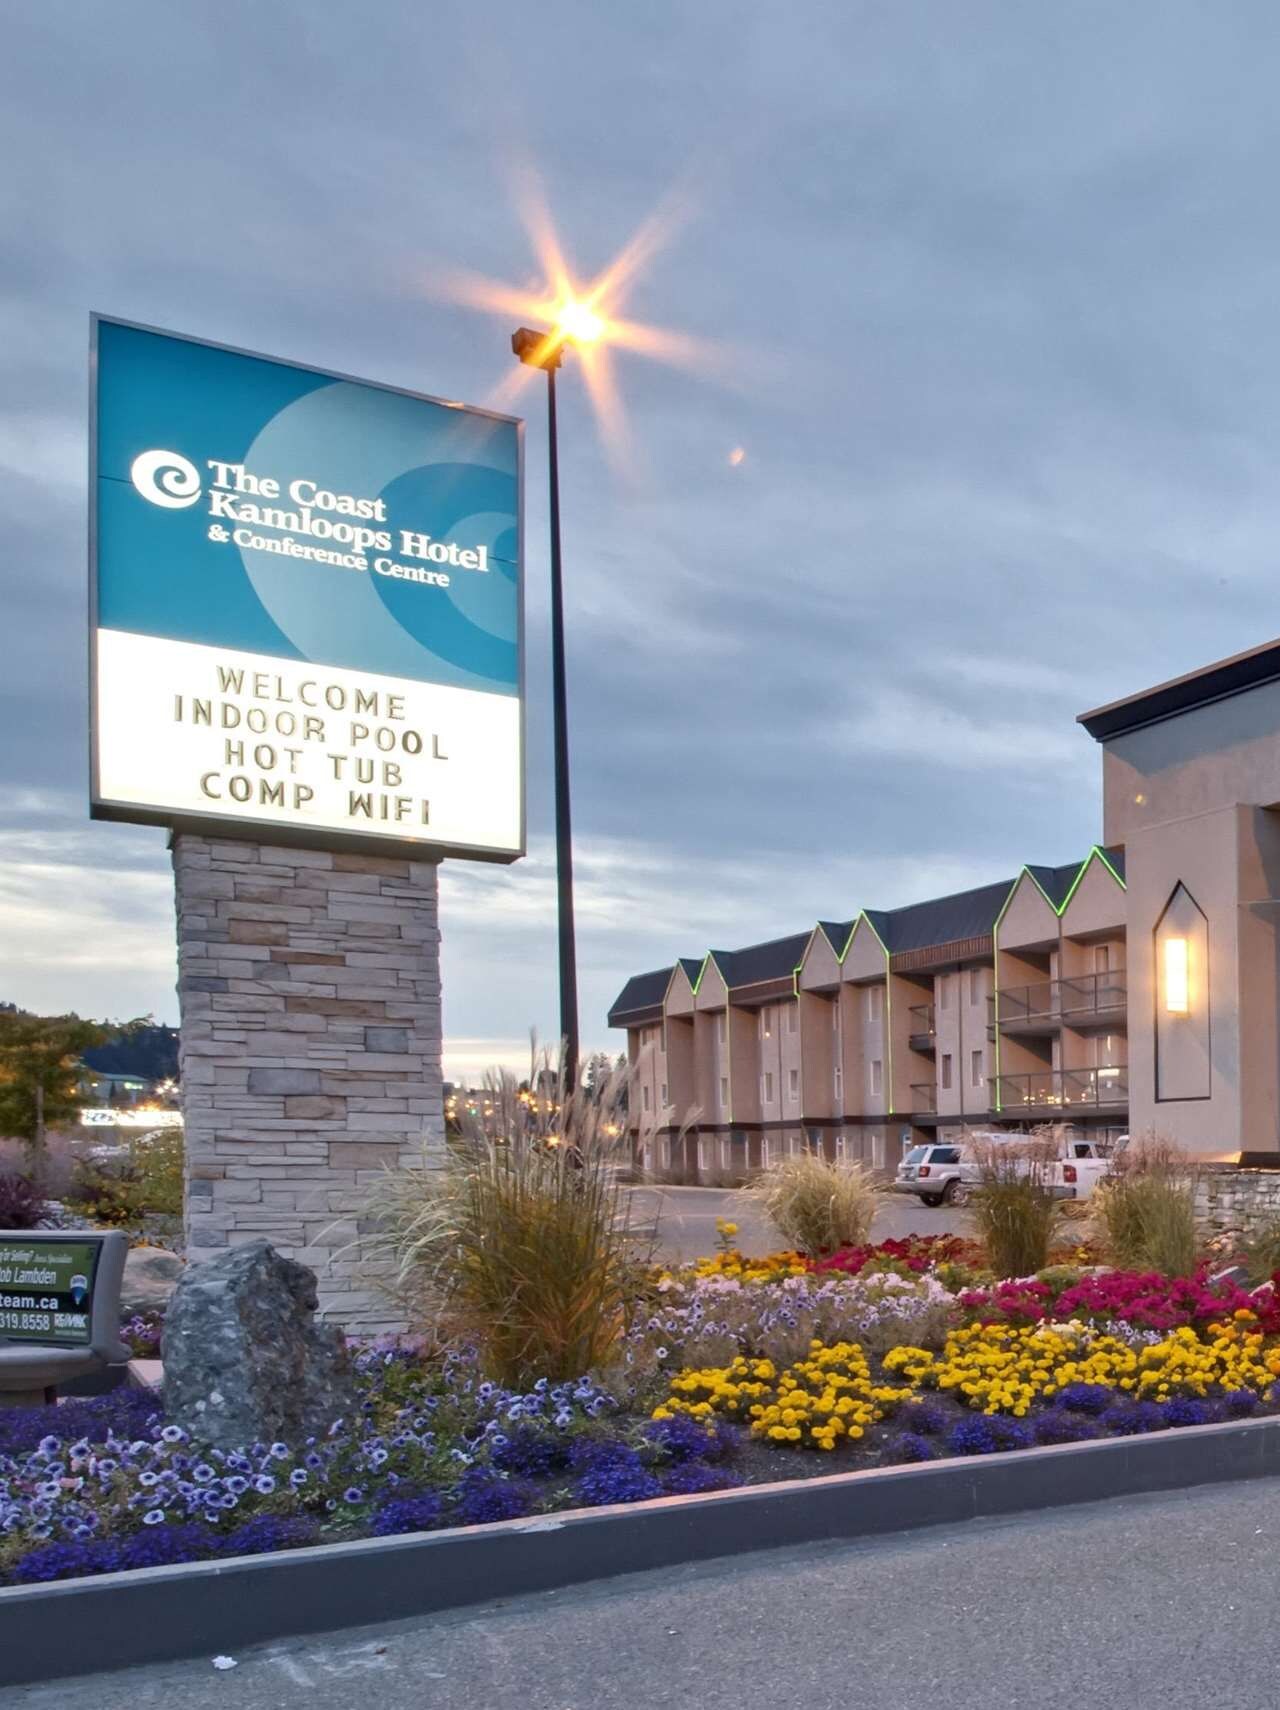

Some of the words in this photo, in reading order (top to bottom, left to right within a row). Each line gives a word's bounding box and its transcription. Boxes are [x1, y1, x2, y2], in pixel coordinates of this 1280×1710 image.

[208, 460, 279, 498] The
[289, 480, 387, 522] Coast
[208, 490, 391, 553] Kamloops
[400, 530, 489, 571] Hotel
[208, 524, 229, 543] &
[233, 529, 368, 571] Conference
[374, 557, 450, 588] Centre
[216, 664, 406, 721] WELCOME
[173, 694, 326, 743] INDOOR
[350, 722, 449, 761] POOL
[224, 738, 302, 774] HOT
[327, 753, 402, 787] TUB
[200, 771, 314, 810] COMP
[348, 790, 430, 825] WIFI
[0, 1267, 11, 1283] ob
[14, 1267, 57, 1285] Lambden
